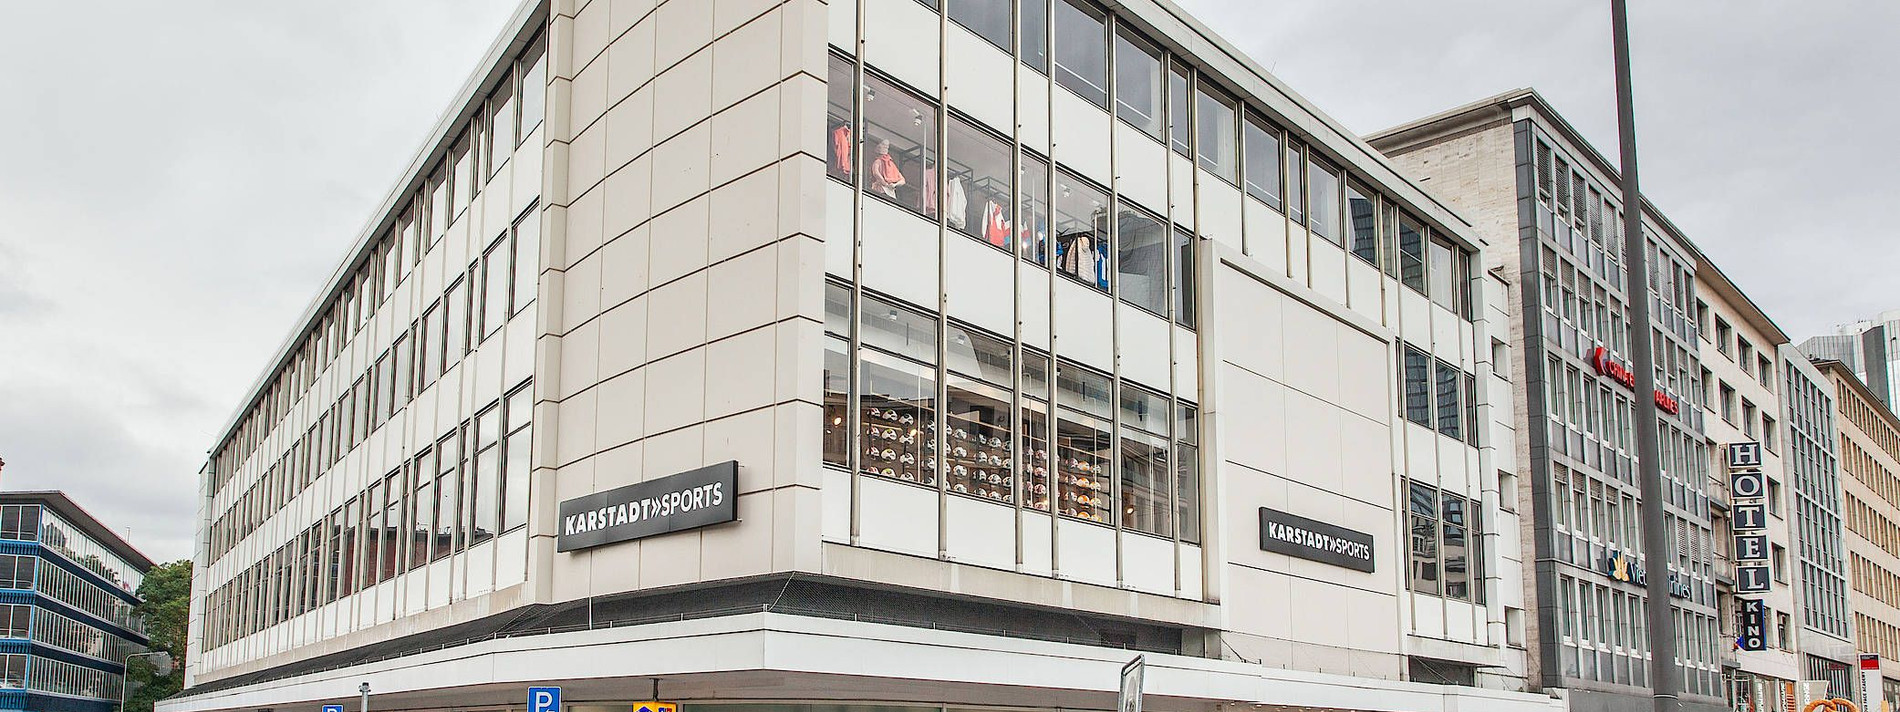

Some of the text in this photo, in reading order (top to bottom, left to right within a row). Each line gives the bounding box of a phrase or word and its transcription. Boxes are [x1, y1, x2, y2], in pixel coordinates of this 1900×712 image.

[1731, 444, 1765, 590] HOTEL
[1746, 602, 1761, 649] KINO
[536, 691, 553, 712] P
